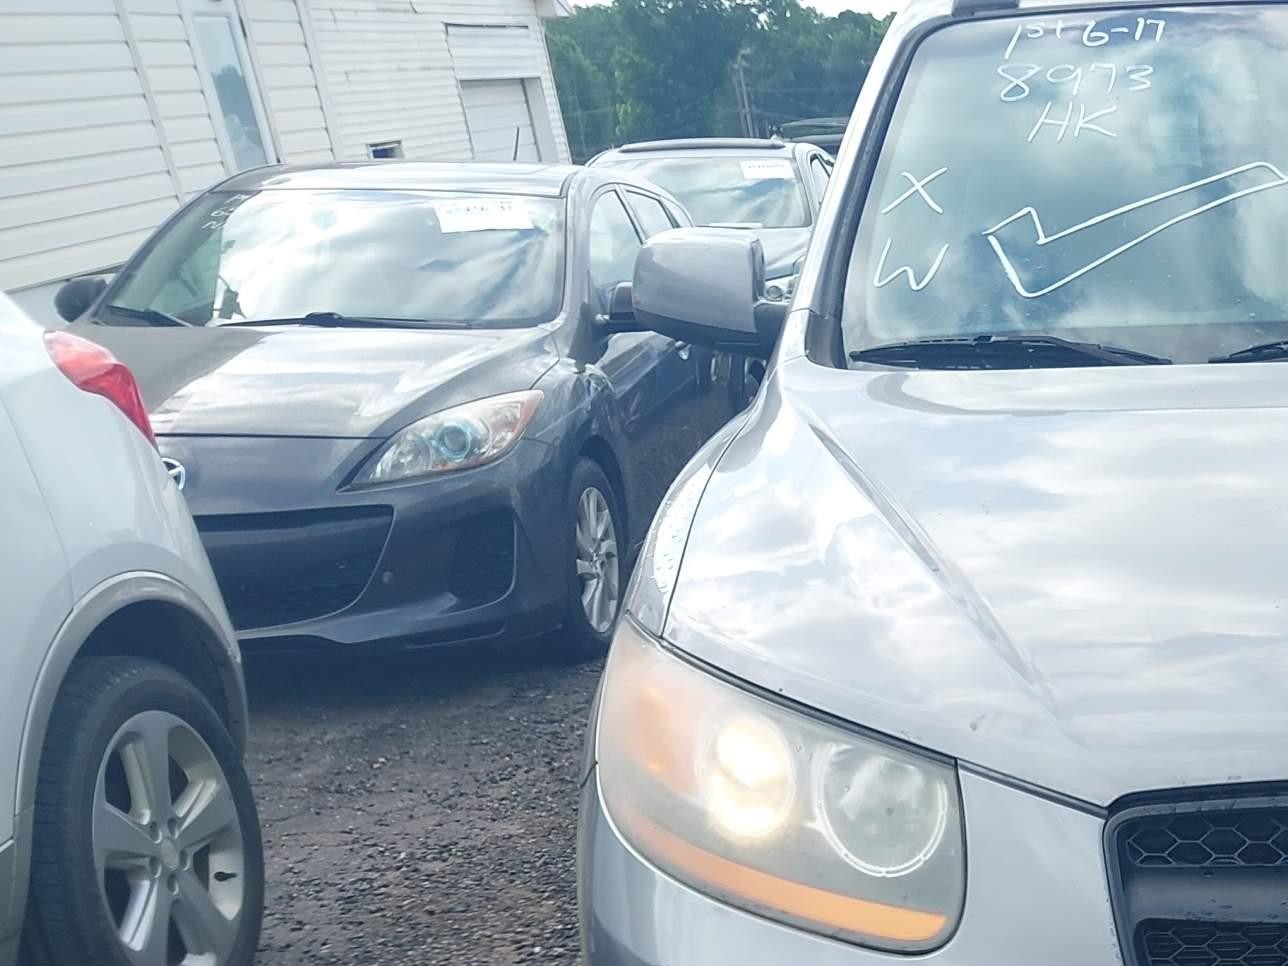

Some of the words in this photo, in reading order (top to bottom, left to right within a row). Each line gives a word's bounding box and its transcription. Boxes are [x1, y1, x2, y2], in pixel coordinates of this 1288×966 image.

[1081, 17, 1167, 47] 6-17
[996, 63, 1154, 102] 8973
[1027, 101, 1118, 142] HK
[873, 238, 949, 291] W
